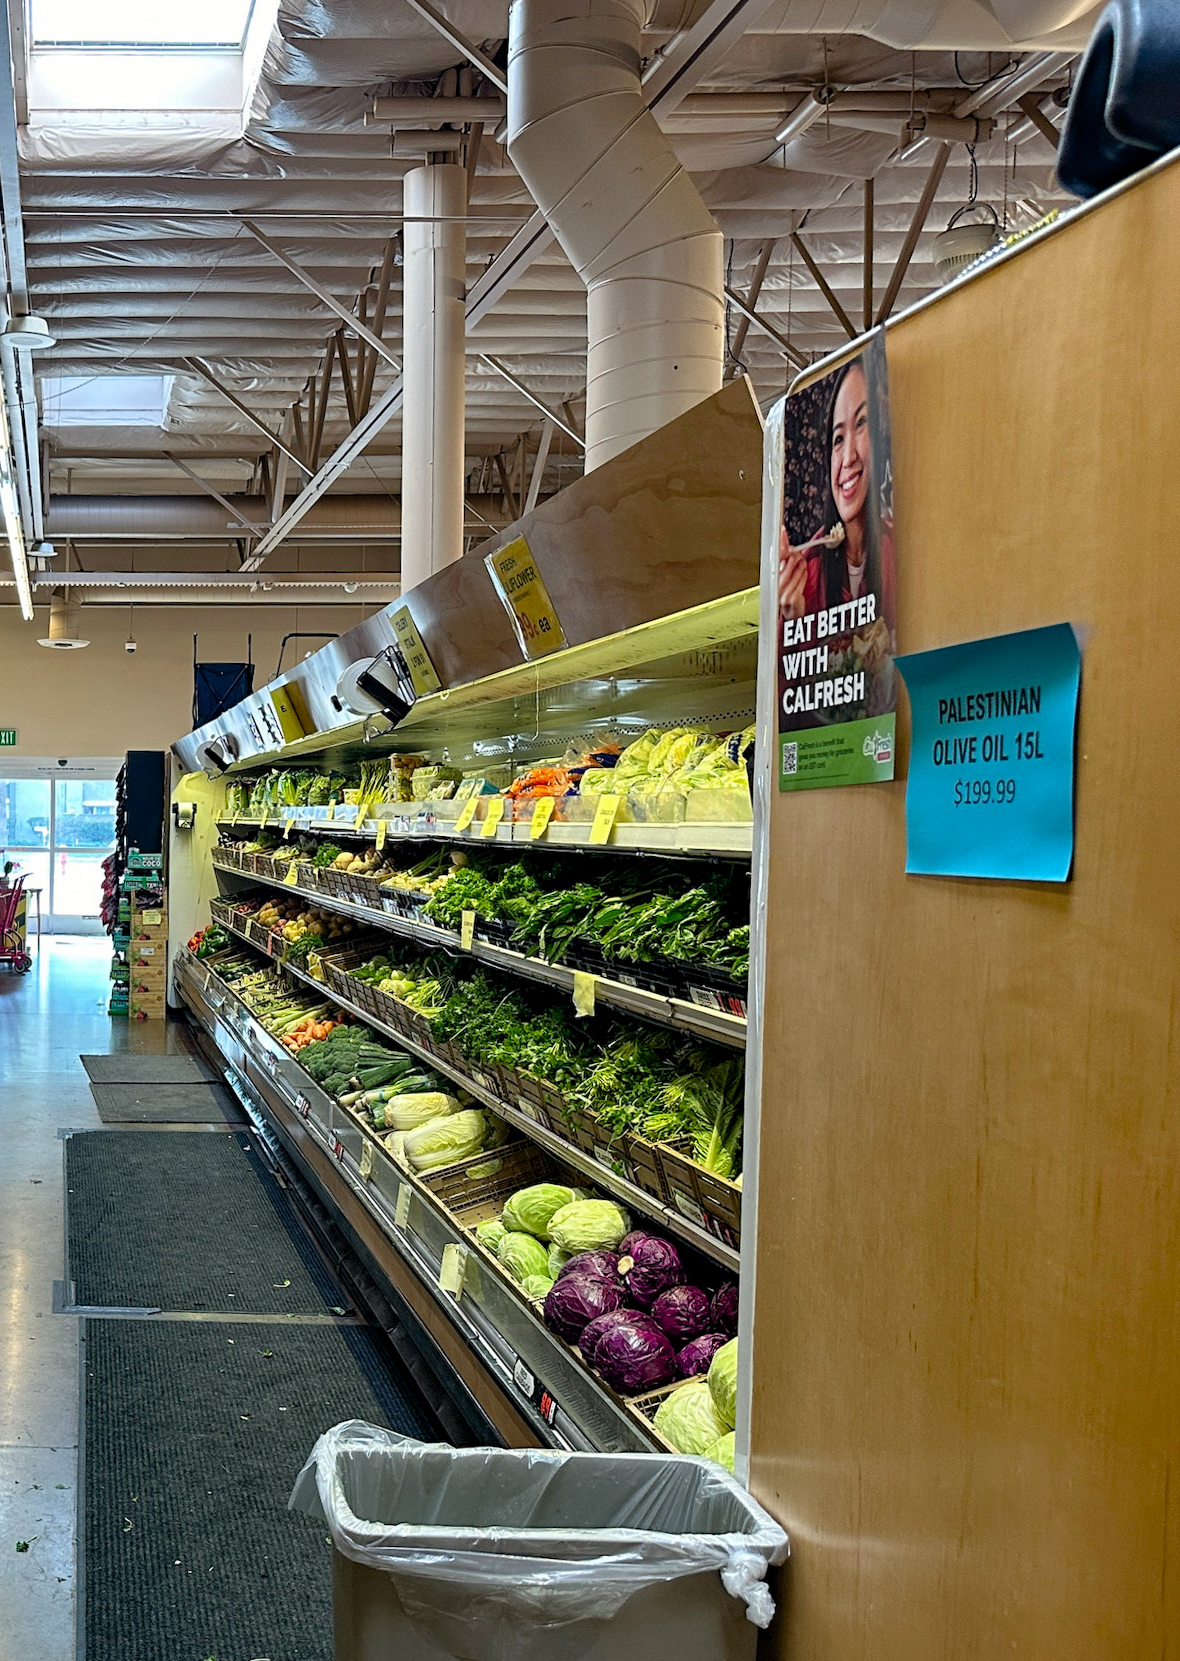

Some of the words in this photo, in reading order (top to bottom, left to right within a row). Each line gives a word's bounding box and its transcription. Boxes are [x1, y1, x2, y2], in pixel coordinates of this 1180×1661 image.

[499, 556, 518, 574] FRESH
[539, 616, 551, 633] ea
[783, 613, 815, 647] EAT
[817, 593, 876, 639] BETTER
[782, 645, 828, 680] WITH
[782, 671, 865, 715] CALFRESH
[939, 686, 1041, 724] PALESTINIAN
[933, 737, 977, 766] OLIVE
[982, 734, 1008, 762] OIL
[1015, 731, 1044, 760] 15L
[954, 779, 1016, 808] $199.99
